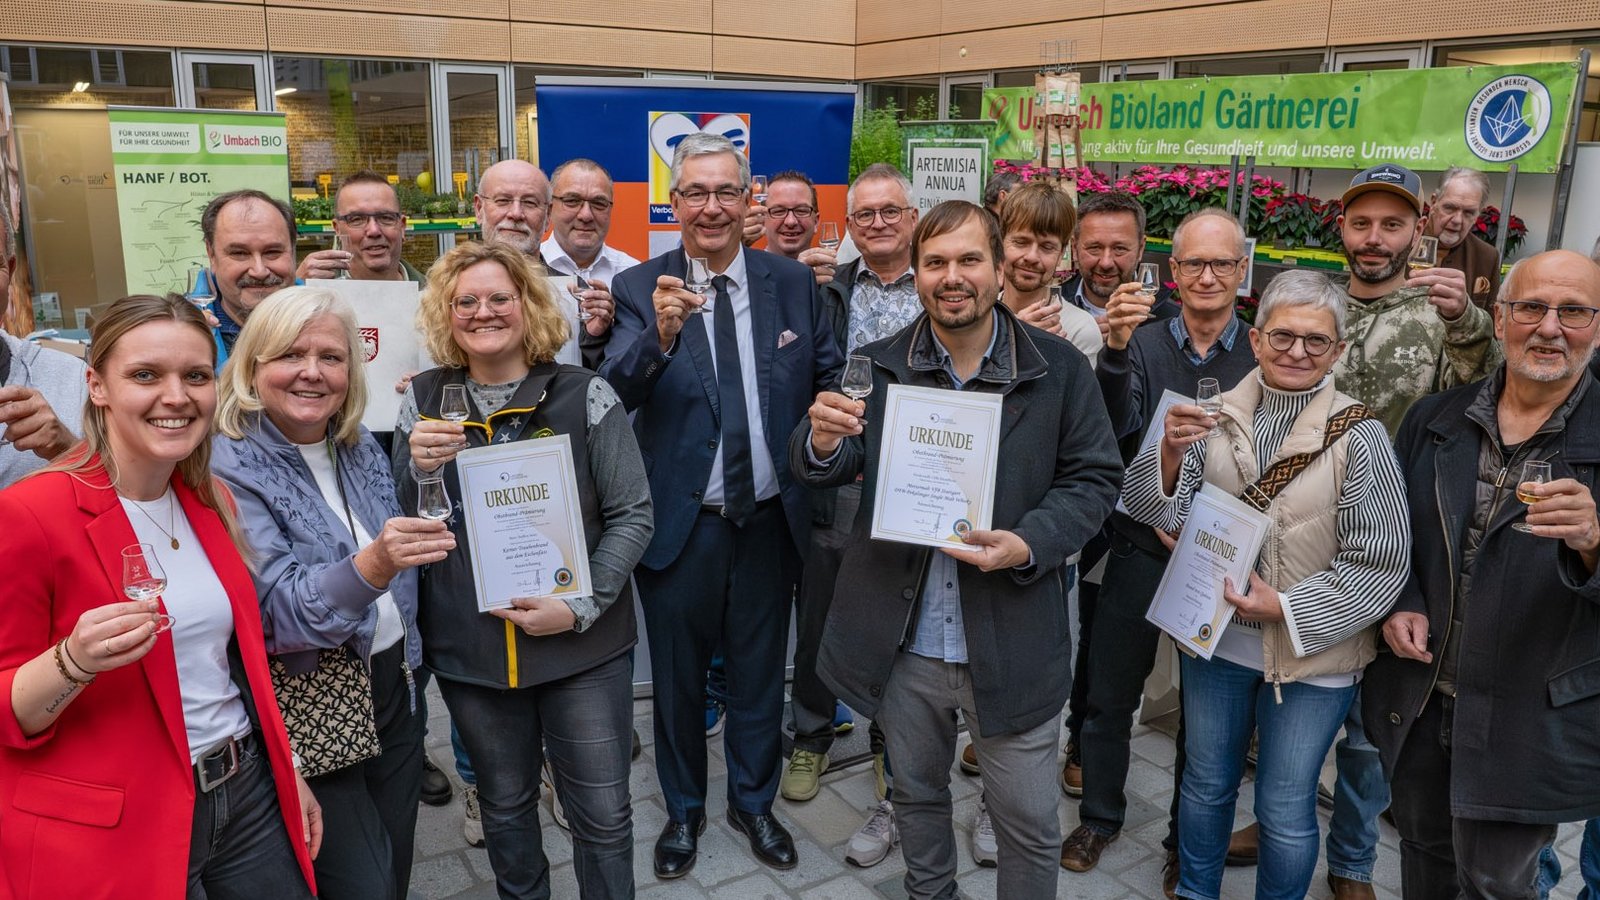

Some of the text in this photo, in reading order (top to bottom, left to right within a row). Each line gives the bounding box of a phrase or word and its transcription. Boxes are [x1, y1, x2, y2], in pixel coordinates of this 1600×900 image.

[1477, 81, 1502, 105] GESUNDER
[1110, 90, 1205, 130] Bioland
[1215, 86, 1360, 129] Gärtnerei
[1470, 108, 1478, 135] PFLANZEN
[1105, 140, 1132, 154] aktiv
[1135, 140, 1152, 157] für
[1156, 140, 1179, 155] Ihre
[1184, 139, 1263, 156] Gesundheit
[1268, 140, 1297, 156] und
[1302, 143, 1355, 159] unsere
[1361, 141, 1437, 160] Umwelt.
[1471, 136, 1488, 154] GESUNDE
[1505, 140, 1530, 157] GESUNDE
[916, 158, 976, 173] ARTEMISIA
[123, 173, 165, 184] HANF
[180, 173, 211, 184] BOT.
[925, 176, 965, 191] ANNUA
[920, 196, 943, 208] EINJÄ
[909, 426, 974, 450] URKUNDE
[484, 483, 550, 508] URKUNDE
[1194, 529, 1238, 562] URKUNDE
